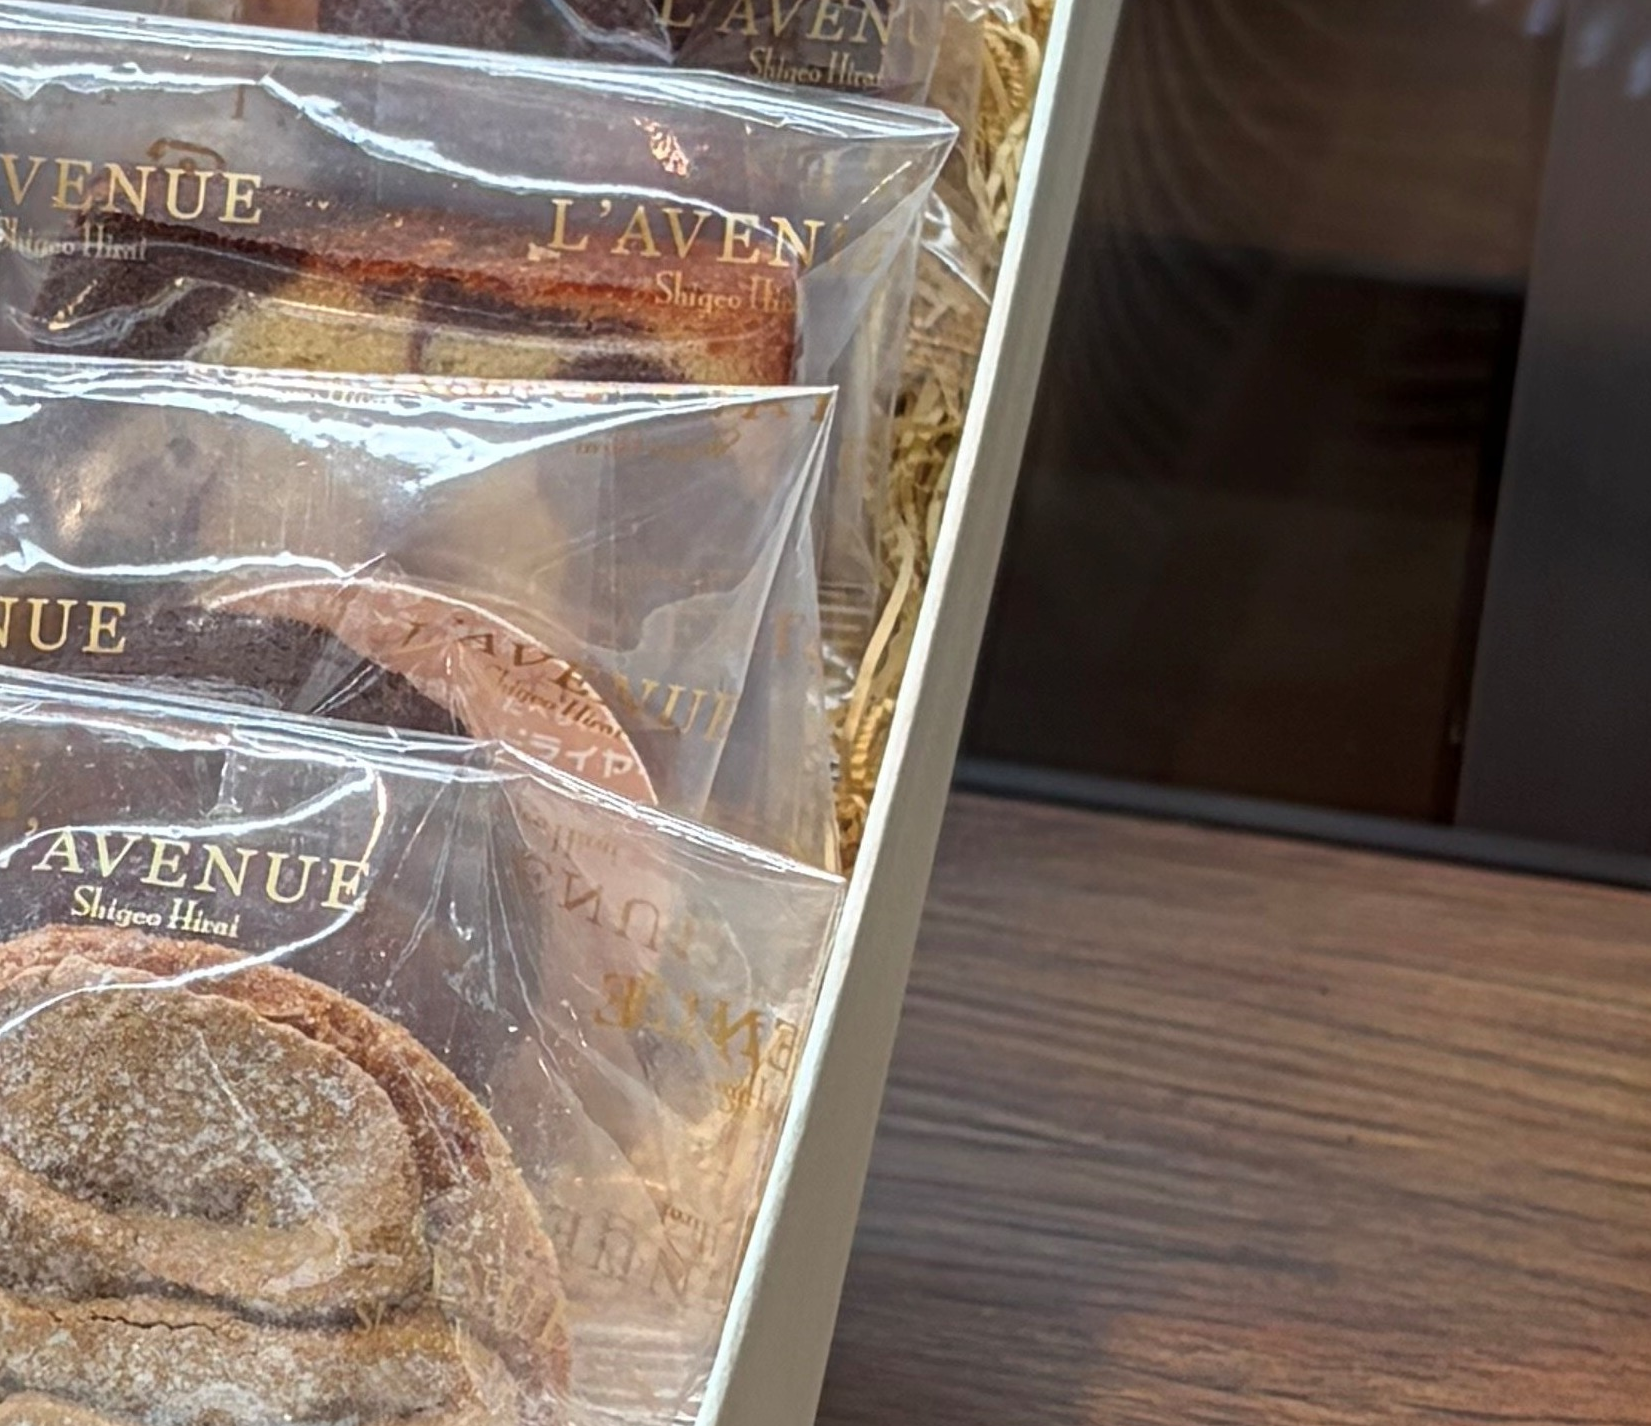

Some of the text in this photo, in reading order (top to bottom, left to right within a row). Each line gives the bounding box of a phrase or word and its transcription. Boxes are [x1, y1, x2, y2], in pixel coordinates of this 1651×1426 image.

[655, 270, 743, 315] Shigeo
[71, 885, 240, 939] Shigeo Hirai
